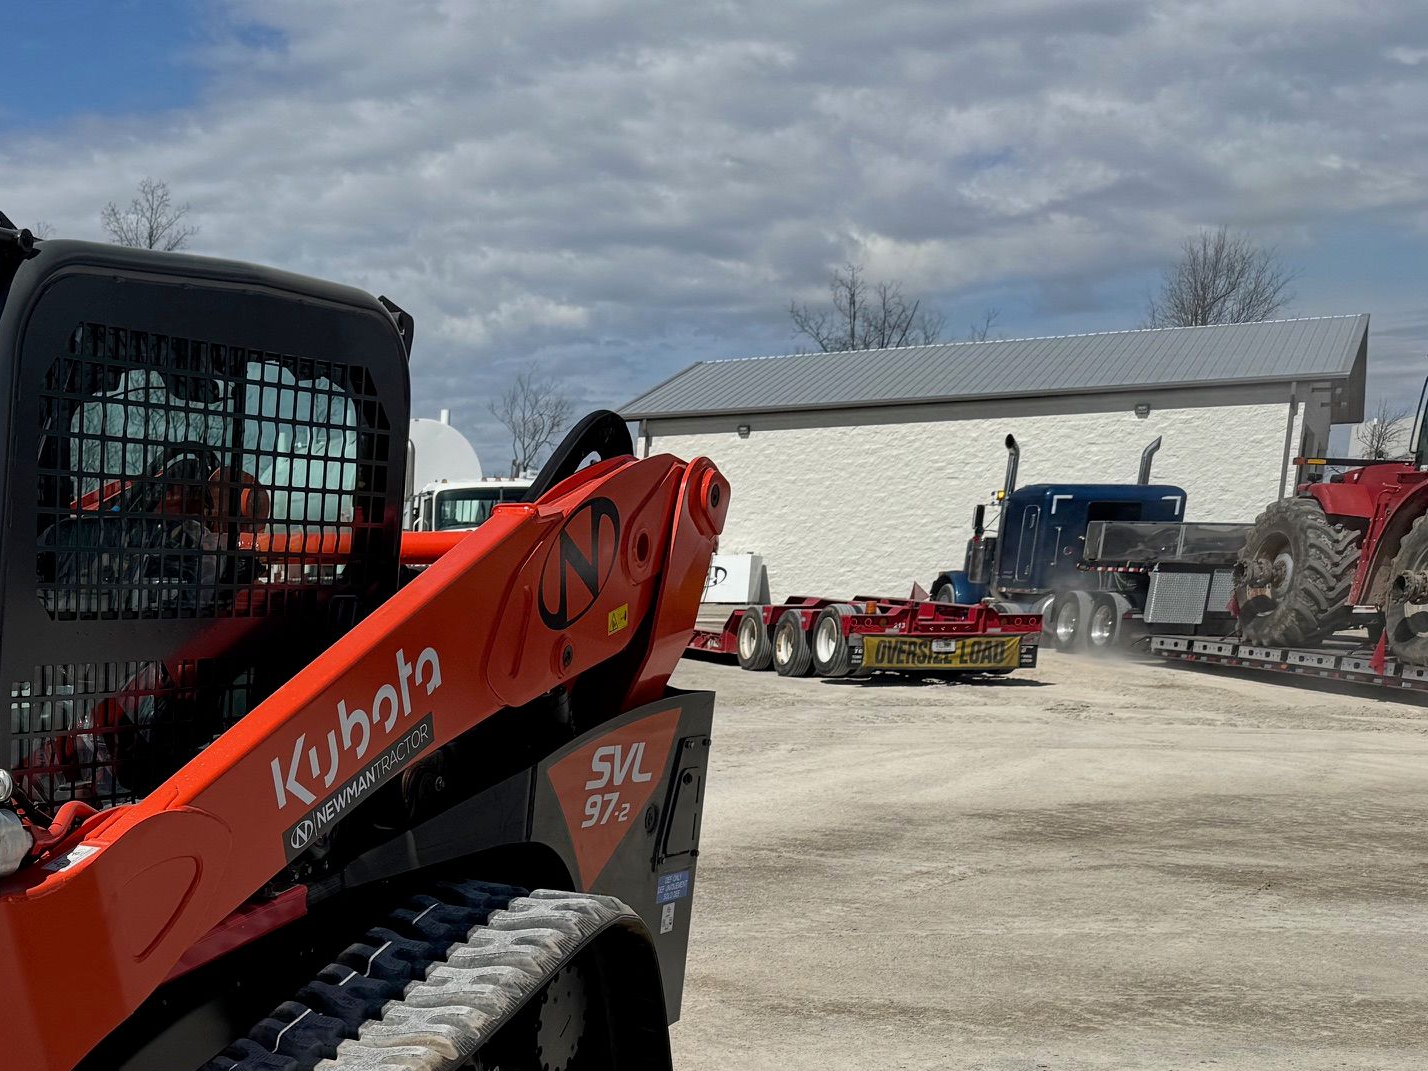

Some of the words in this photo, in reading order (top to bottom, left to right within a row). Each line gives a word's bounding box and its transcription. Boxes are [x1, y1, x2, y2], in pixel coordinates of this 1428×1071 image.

[959, 639, 1007, 665] LOAD
[271, 647, 442, 810] Kubota
[585, 742, 652, 790] SVL
[581, 792, 631, 828] 97-2
